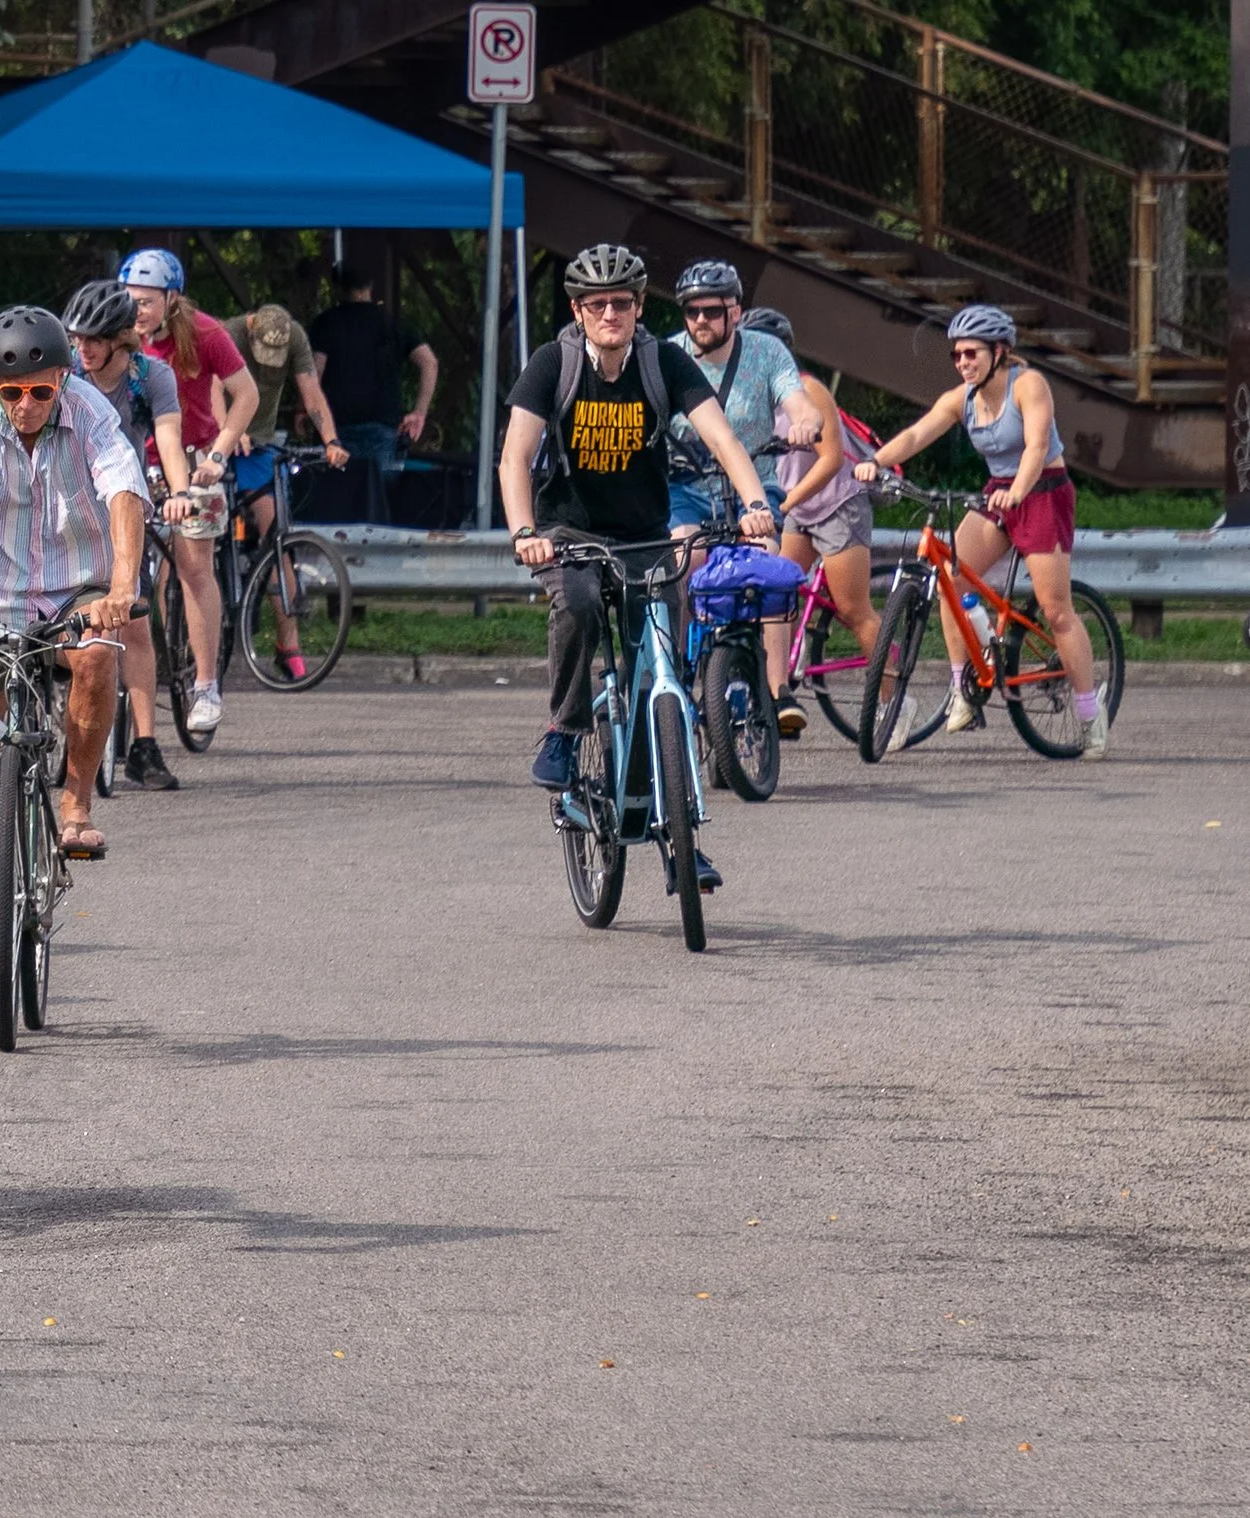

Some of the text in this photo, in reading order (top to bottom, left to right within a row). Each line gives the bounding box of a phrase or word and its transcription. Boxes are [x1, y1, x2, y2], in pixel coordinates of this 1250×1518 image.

[574, 400, 644, 428] WORKING
[570, 426, 643, 451] FAMILIES
[578, 450, 632, 472] PARTY
